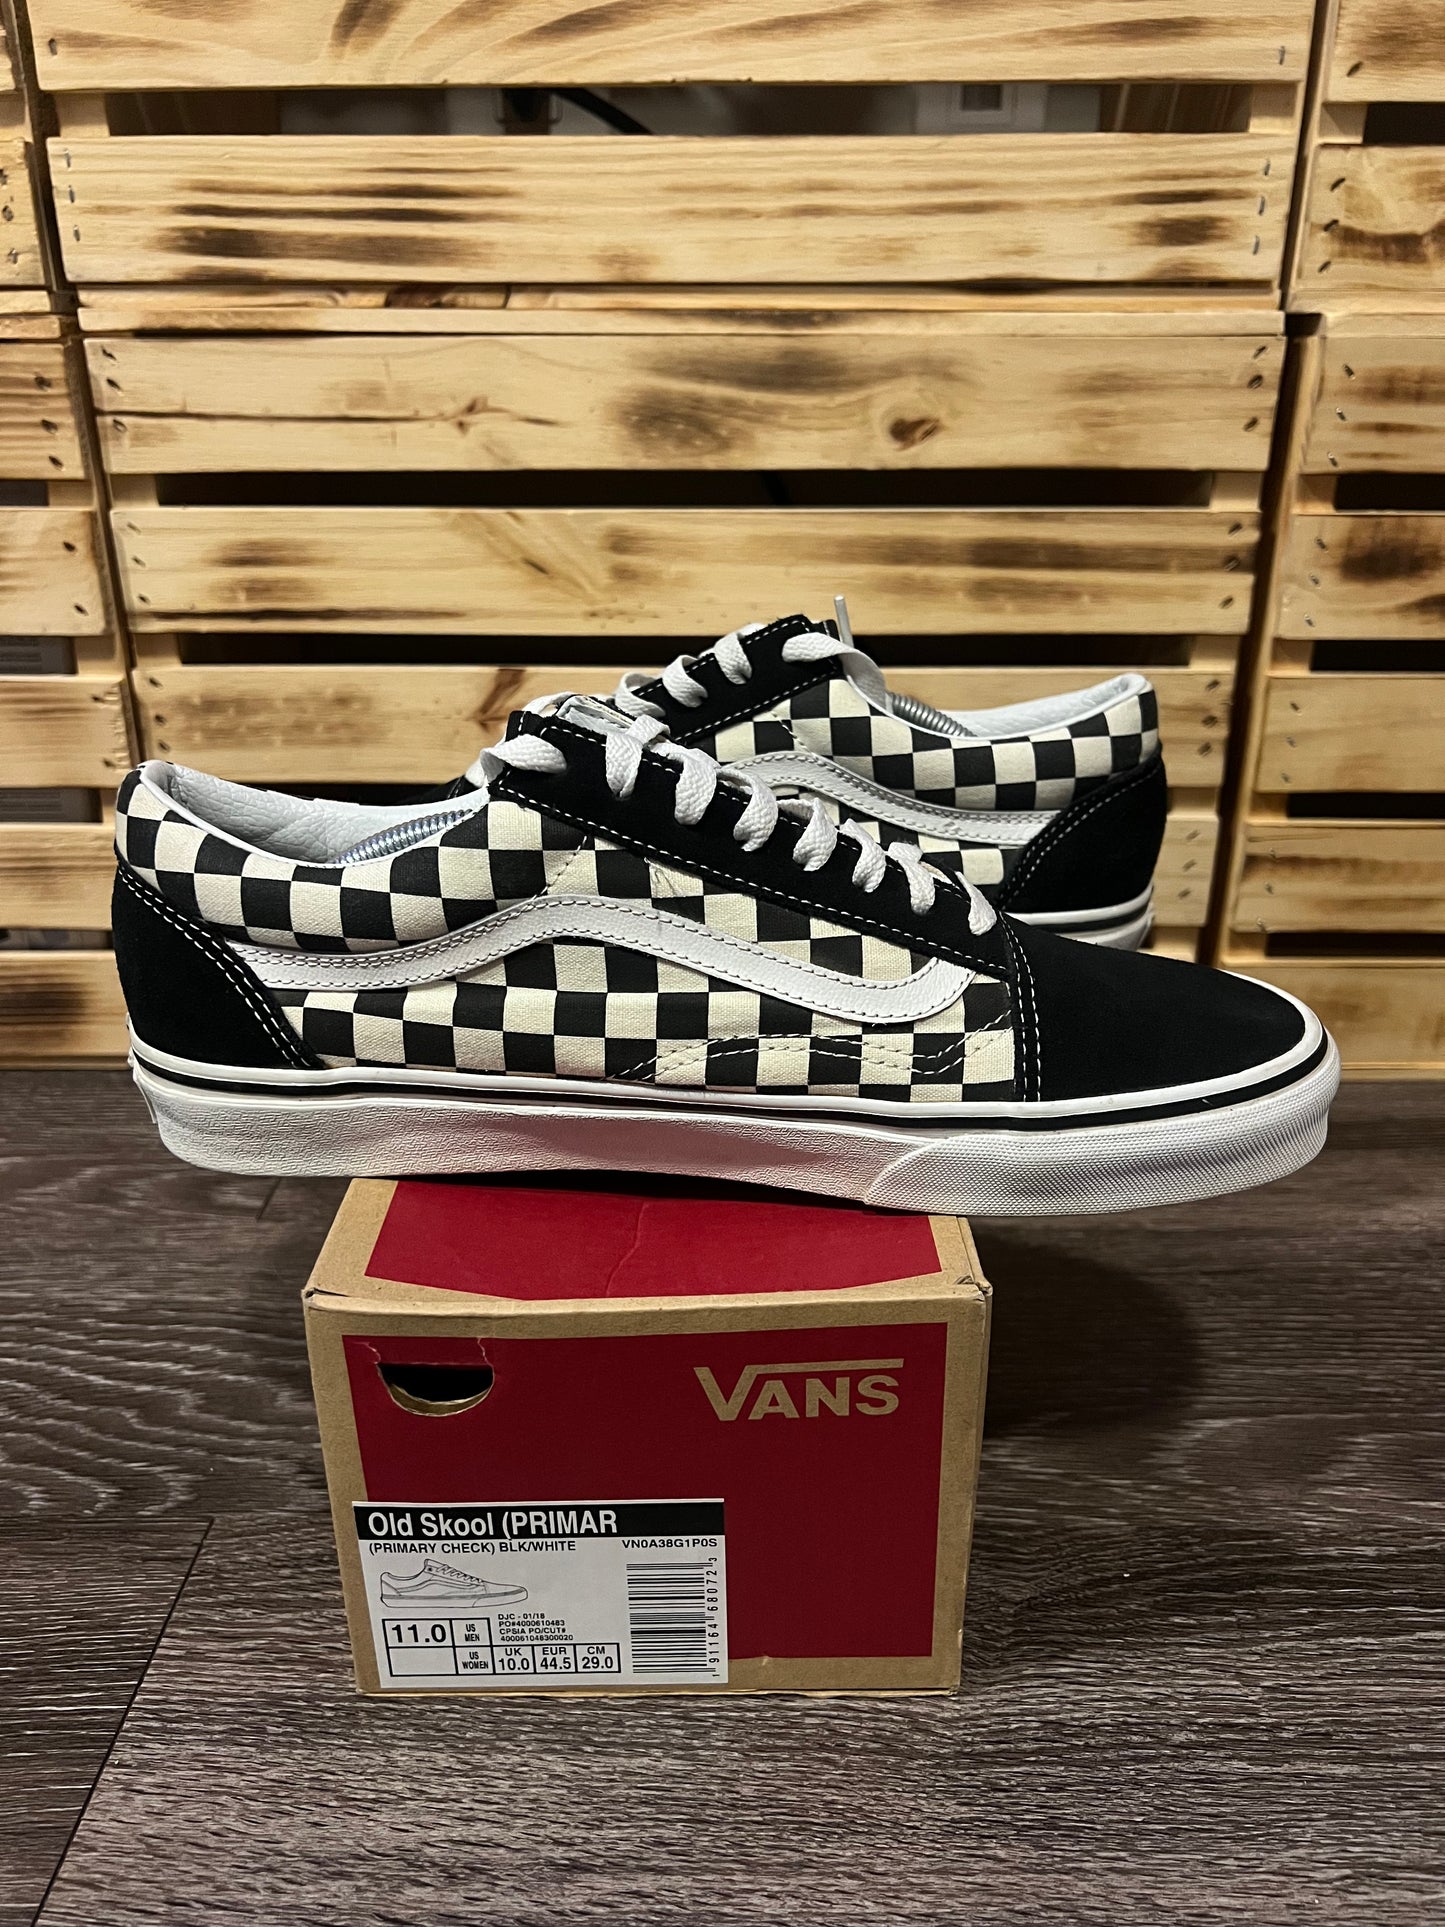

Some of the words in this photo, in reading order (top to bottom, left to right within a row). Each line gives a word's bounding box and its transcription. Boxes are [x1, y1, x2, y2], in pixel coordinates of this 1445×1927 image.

[694, 1358, 904, 1421] VANS
[368, 1511, 413, 1537] Old
[421, 1511, 495, 1537] Skool
[502, 1510, 617, 1540] (PRIMAR
[369, 1542, 436, 1555] (PRIMARY
[441, 1541, 495, 1555] CHECK)
[499, 1540, 576, 1552] BLK/WHITE
[706, 1570, 719, 1612] 68072
[522, 1612, 546, 1620] 01/18
[465, 1623, 476, 1633] US
[498, 1619, 565, 1627] PO#4000610483
[391, 1623, 447, 1643] 11.0
[499, 1627, 526, 1635] CPSIA
[464, 1633, 480, 1642] MEN
[708, 1623, 720, 1663] 91164
[504, 1647, 523, 1657] UK
[541, 1646, 567, 1656] EUR
[587, 1645, 606, 1655] CM
[468, 1651, 480, 1660] US
[462, 1660, 489, 1670] WOMEN
[498, 1657, 530, 1671] 10.0
[540, 1656, 572, 1670] 44.5
[581, 1656, 614, 1670] 29.0
